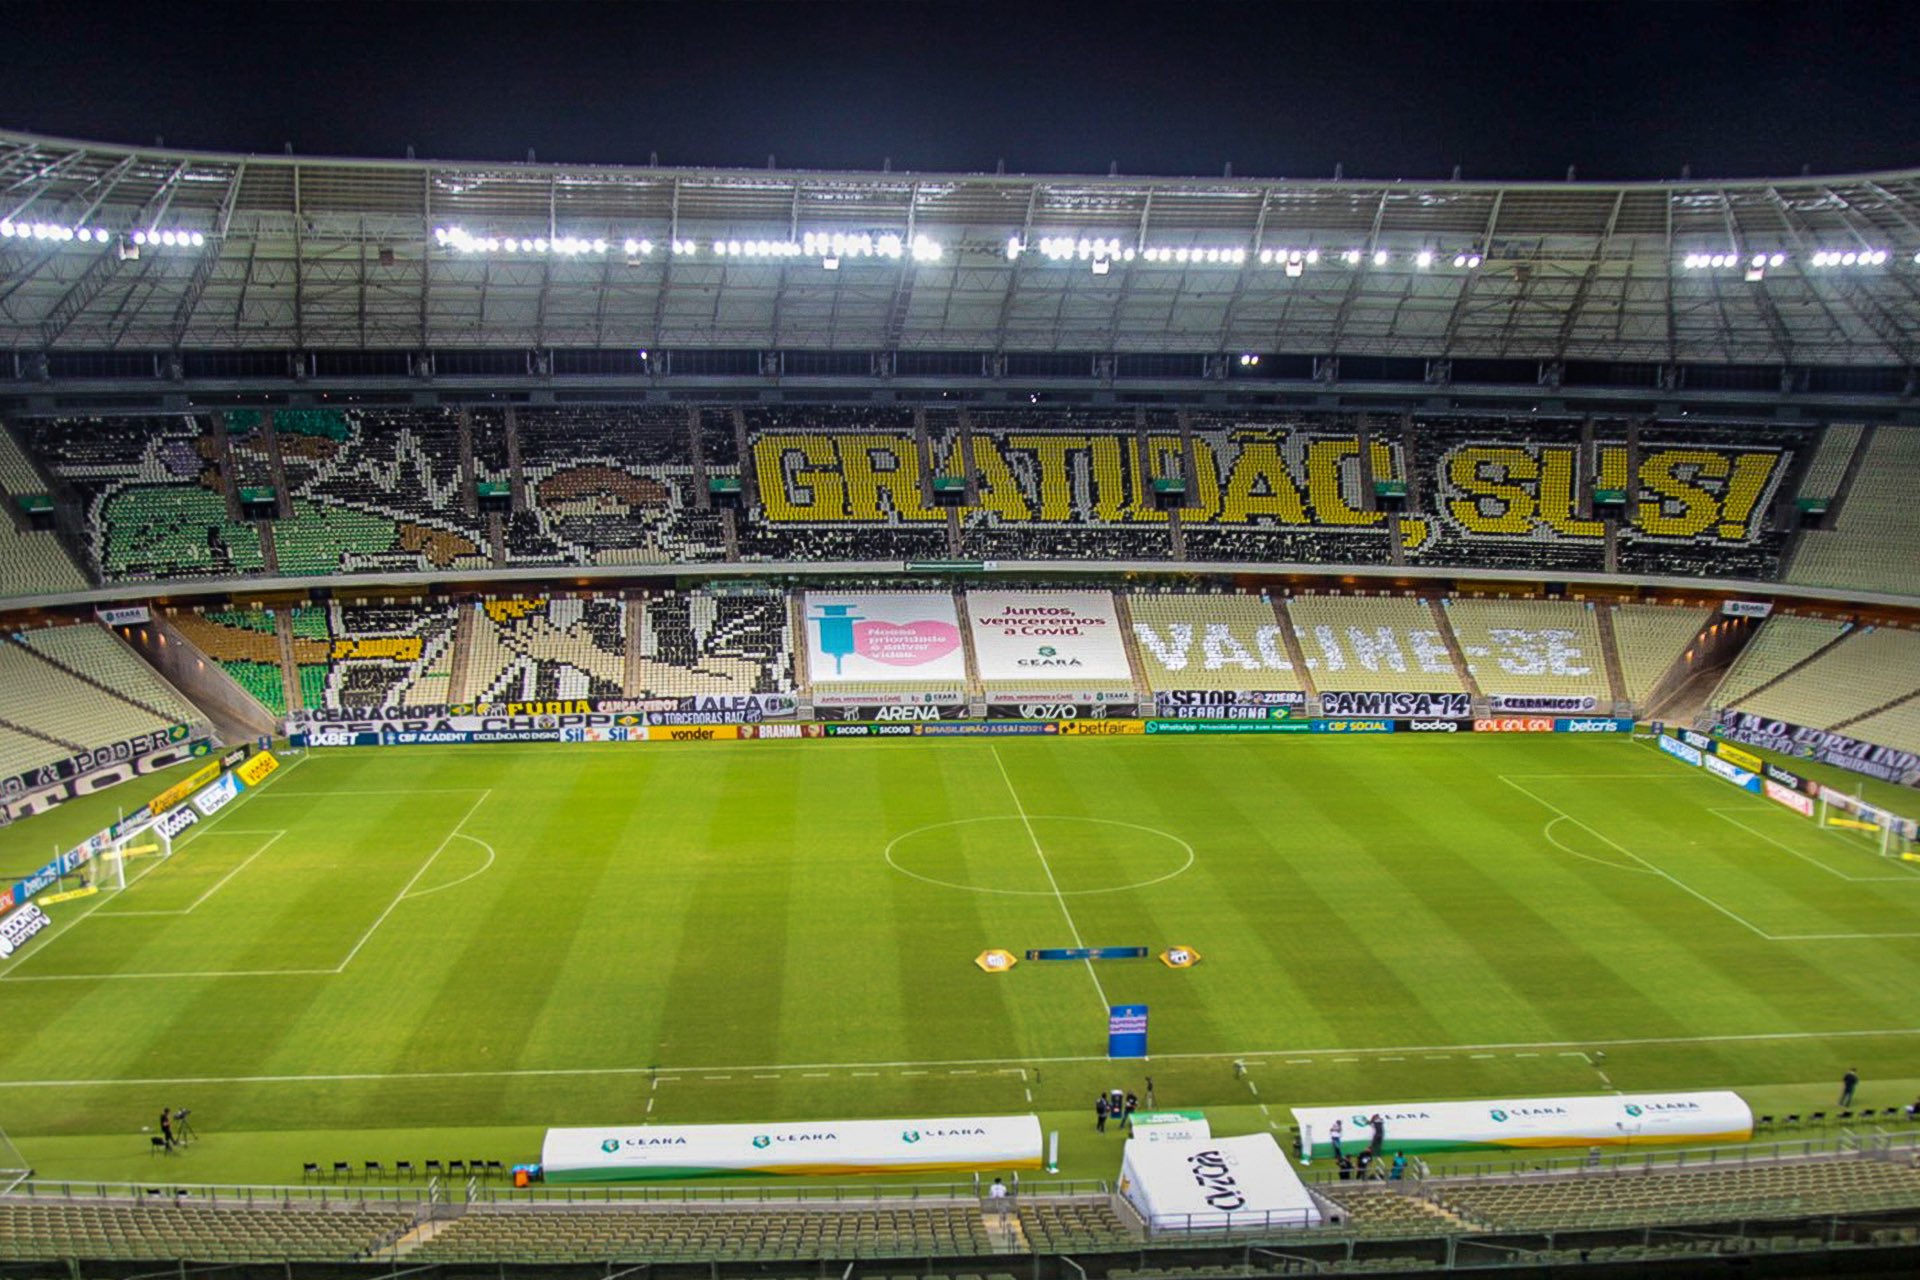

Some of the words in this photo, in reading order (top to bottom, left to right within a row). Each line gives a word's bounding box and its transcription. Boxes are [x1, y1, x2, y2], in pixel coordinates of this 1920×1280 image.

[1440, 441, 1788, 546] SUS!
[1002, 606, 1076, 617] Juntos,
[979, 617, 1106, 626] venceremos
[1004, 627, 1016, 635] a
[1021, 626, 1085, 636] Covid.
[1171, 690, 1237, 706] SETOR
[1264, 693, 1304, 704] ZUEIRA
[1322, 691, 1433, 716] CAMISA
[1438, 693, 1468, 715] 14
[1503, 697, 1581, 710] CEARAMIGOS
[507, 700, 592, 717] FURIA
[875, 706, 941, 720] ARENA
[1229, 707, 1267, 719] CANA
[664, 712, 723, 725] TORCEDORAS
[759, 724, 802, 738] BRAHMA
[836, 726, 868, 735] SICOOB
[880, 726, 911, 734] SICOOB
[1328, 721, 1350, 732] CBF
[1351, 721, 1388, 732] SOCIAL
[1411, 720, 1457, 732] bodog
[1474, 719, 1500, 732] GOL
[1502, 719, 1526, 732] GOL
[1528, 719, 1553, 732] GOL
[398, 734, 416, 743] CBF
[418, 733, 467, 743] ACADEMY
[531, 732, 560, 740] ENSINO
[565, 727, 585, 742] Sil
[608, 727, 628, 741] Sil
[671, 728, 716, 740] vonder
[73, 729, 171, 774] PODER
[1769, 764, 1798, 789] bodog
